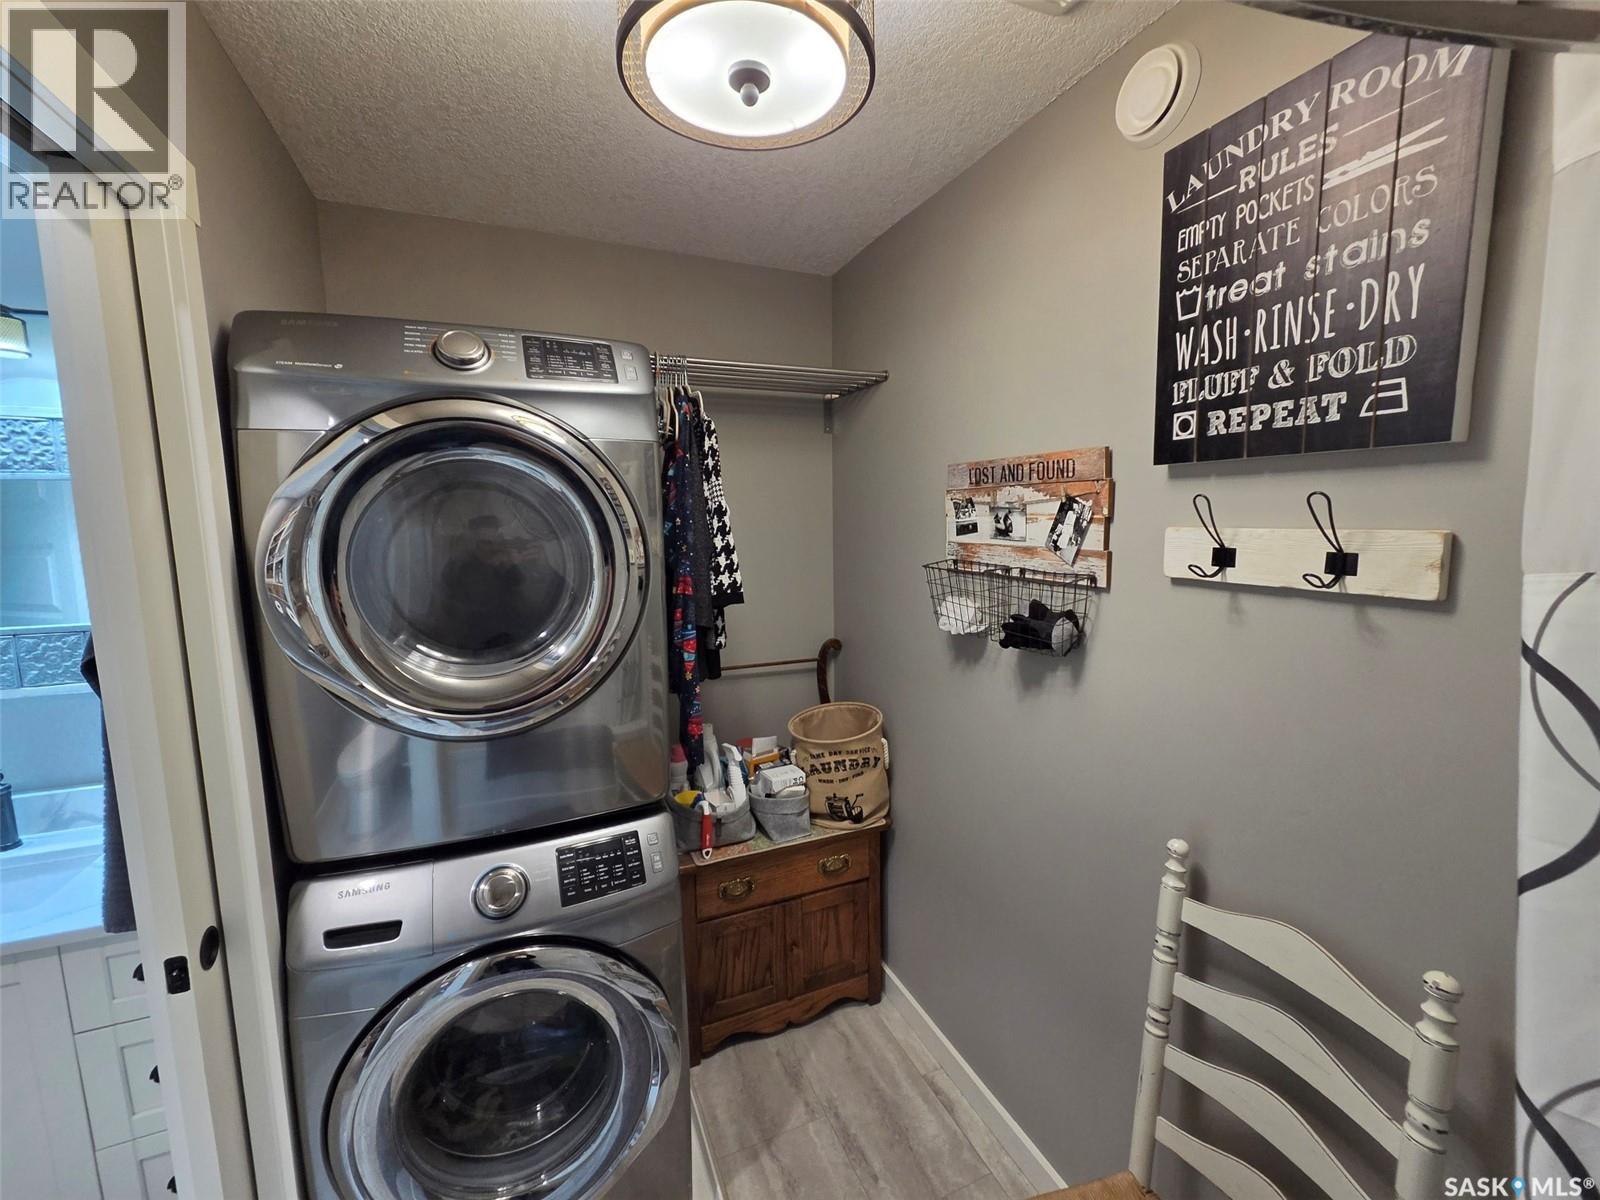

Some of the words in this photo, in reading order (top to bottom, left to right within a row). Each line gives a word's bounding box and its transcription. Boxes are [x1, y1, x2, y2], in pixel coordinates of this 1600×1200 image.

[1166, 92, 1321, 214] LAUNDRY
[1328, 45, 1475, 112] ROOM
[1238, 122, 1340, 195] RULES
[1177, 211, 1227, 253] EMPTY
[1235, 174, 1315, 230] POCKETS
[1177, 217, 1302, 283] SEPARATE
[1316, 164, 1438, 234] COLORS
[1205, 261, 1286, 311] treat
[1304, 217, 1430, 281] stains
[1171, 364, 1260, 406] FLUFF
[1267, 359, 1296, 389] &
[1305, 334, 1418, 383] FOLD
[1206, 391, 1348, 436] REPEAT
[968, 466, 996, 485] LOST
[1000, 463, 1024, 483] AND
[1029, 458, 1076, 482] FOUND
